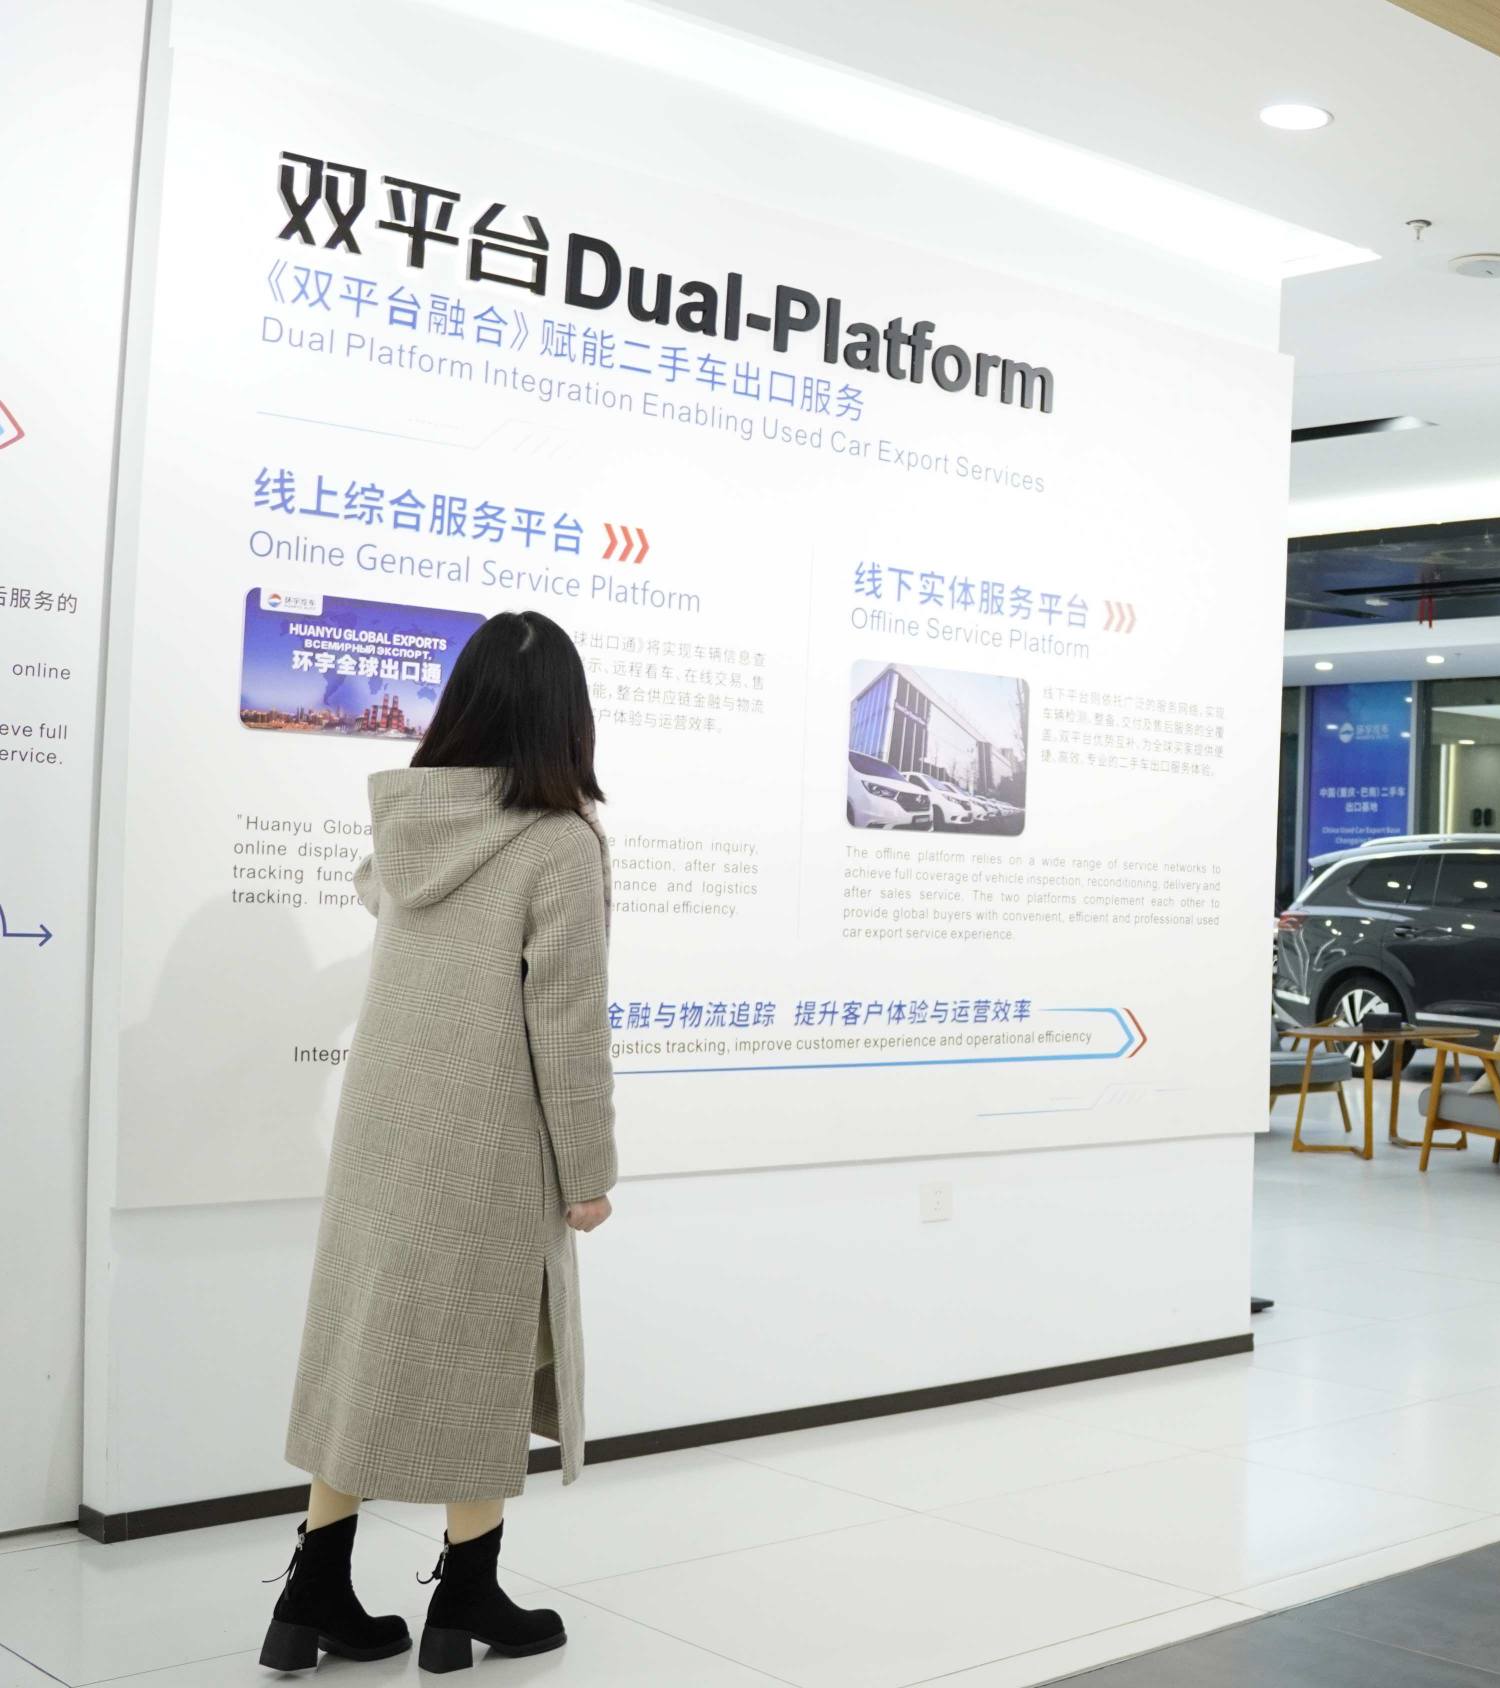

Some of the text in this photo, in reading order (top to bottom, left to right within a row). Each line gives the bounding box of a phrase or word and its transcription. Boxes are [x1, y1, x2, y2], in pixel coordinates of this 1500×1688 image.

[276, 151, 1054, 413] 双平台 Dual-Platform
[267, 259, 864, 421] 《双平台融合》赋能二手车出口服务
[262, 316, 1046, 493] Dual Platform Integration Enabling Used Car Export Services
[253, 467, 584, 555] 线上综合服务平台
[250, 530, 701, 613] Online General Service Platform
[855, 561, 1089, 629] 线下实体服务平台
[289, 623, 447, 651] HUANYU GLOBAL EXPORTS
[851, 607, 1090, 659] Offline Service Platform
[12, 662, 71, 680] online
[291, 650, 442, 684] 环宇全球出口通
[583, 656, 764, 690] 示、远程看车、在线交易、售
[587, 682, 764, 714] 能，整合供应链金融与物流
[39, 722, 67, 740] full
[594, 708, 722, 734] 户体验与运营效率。
[234, 841, 362, 861] online display,
[624, 836, 703, 851] information
[233, 864, 304, 884] tracking
[685, 859, 716, 873] after
[723, 861, 759, 874] sales
[845, 846, 1222, 875] The offline platform relies on a wide range of service networks to
[667, 880, 693, 893] and
[702, 881, 758, 897] logistics
[844, 867, 892, 880] achieve
[895, 868, 913, 880] full
[915, 870, 969, 884] coverage
[971, 871, 983, 882] of
[985, 872, 1024, 884] vehicle
[1163, 878, 1201, 893] delivery
[1203, 881, 1221, 892] and
[232, 888, 307, 908] tracking.
[843, 886, 872, 898] after
[880, 888, 912, 899] sales
[972, 890, 993, 902] The
[1001, 892, 1020, 902] two
[1027, 893, 1077, 905] platforms
[1083, 894, 1145, 907] complement
[1151, 896, 1174, 907] each
[1180, 897, 1205, 908] other
[1211, 898, 1220, 909] to
[843, 907, 888, 921] provide
[893, 908, 929, 922] global
[933, 909, 972, 922] buyers
[975, 909, 998, 920] with
[1069, 912, 1109, 923] efficient
[1112, 913, 1130, 924] and
[1134, 913, 1194, 926] professional
[1197, 914, 1220, 926] used
[842, 927, 862, 938] car
[865, 927, 903, 940] export
[906, 928, 947, 939] service
[608, 999, 1032, 1029] 金融与物流追踪 提升客户体验与运营效率
[666, 1038, 731, 1055] tracking,
[735, 1037, 792, 1057] improve
[796, 1037, 861, 1050] customer
[864, 1034, 936, 1051] experience
[940, 1033, 963, 1047] and
[967, 1032, 1035, 1048] operational
[1038, 1030, 1092, 1045] efficiency
